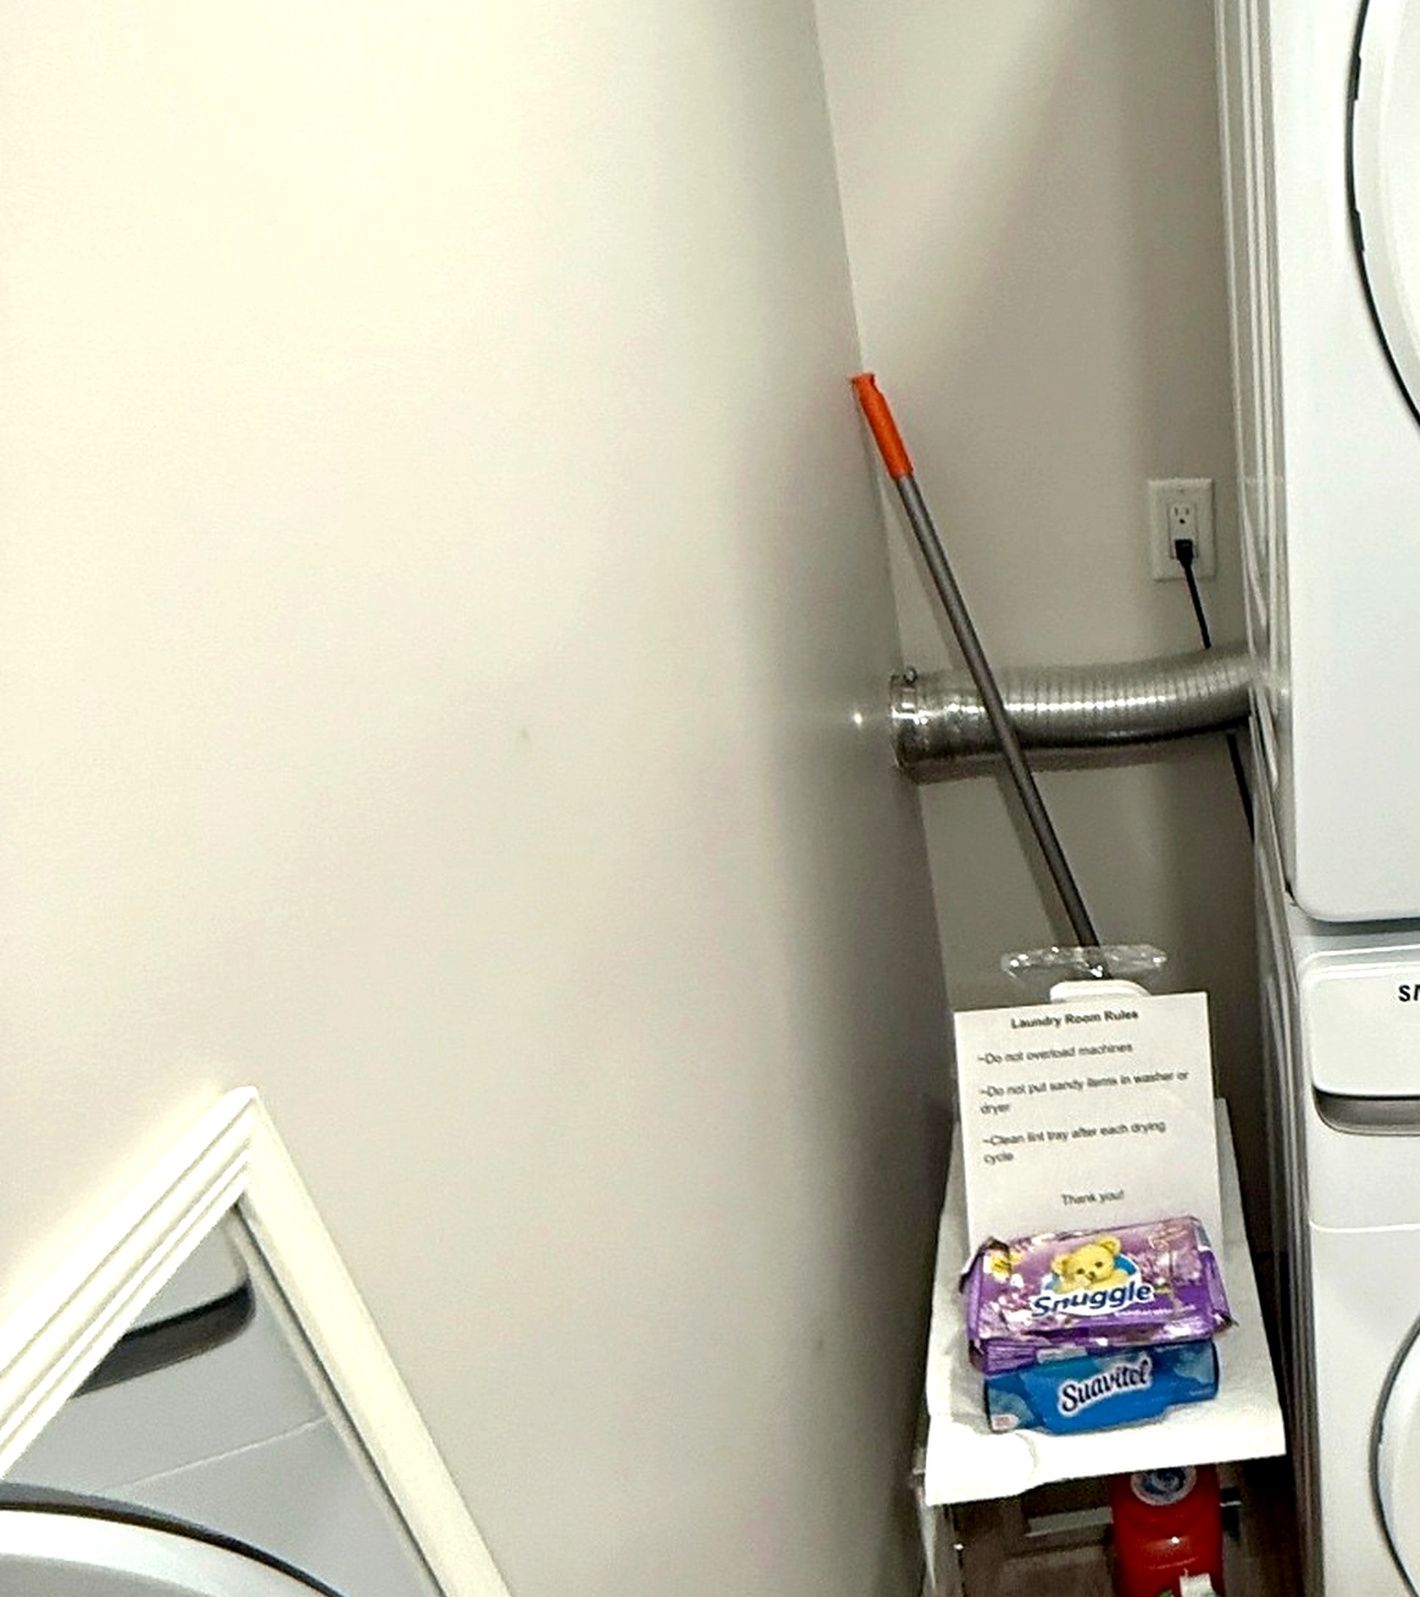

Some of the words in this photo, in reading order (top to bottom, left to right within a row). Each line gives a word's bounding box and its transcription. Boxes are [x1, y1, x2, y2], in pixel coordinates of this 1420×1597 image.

[1011, 1014, 1062, 1030] Laundry
[1065, 1012, 1102, 1024] Room
[1104, 1009, 1139, 1022] Rules
[1004, 1050, 1025, 1063] not
[1026, 1046, 1076, 1062] overload
[1078, 1042, 1133, 1055] machines
[1007, 1084, 1027, 1096] not
[1028, 1082, 1047, 1095] put
[1050, 1078, 1085, 1092] sandy
[1086, 1076, 1118, 1088] items
[1120, 1075, 1132, 1086] in
[1134, 1071, 1174, 1085] washer
[1176, 1071, 1190, 1081] or
[980, 1102, 1011, 1116] dryer
[1026, 1130, 1046, 1143] lint
[1047, 1129, 1070, 1143] tray
[1071, 1125, 1097, 1139] after
[1100, 1123, 1129, 1136] each
[1130, 1120, 1167, 1134] drying
[983, 1152, 1014, 1165] cycle
[1061, 1192, 1097, 1206] Thank
[1099, 1189, 1124, 1203] you!
[1032, 1282, 1151, 1317] Snuggle
[1061, 1358, 1150, 1412] Suavitel
